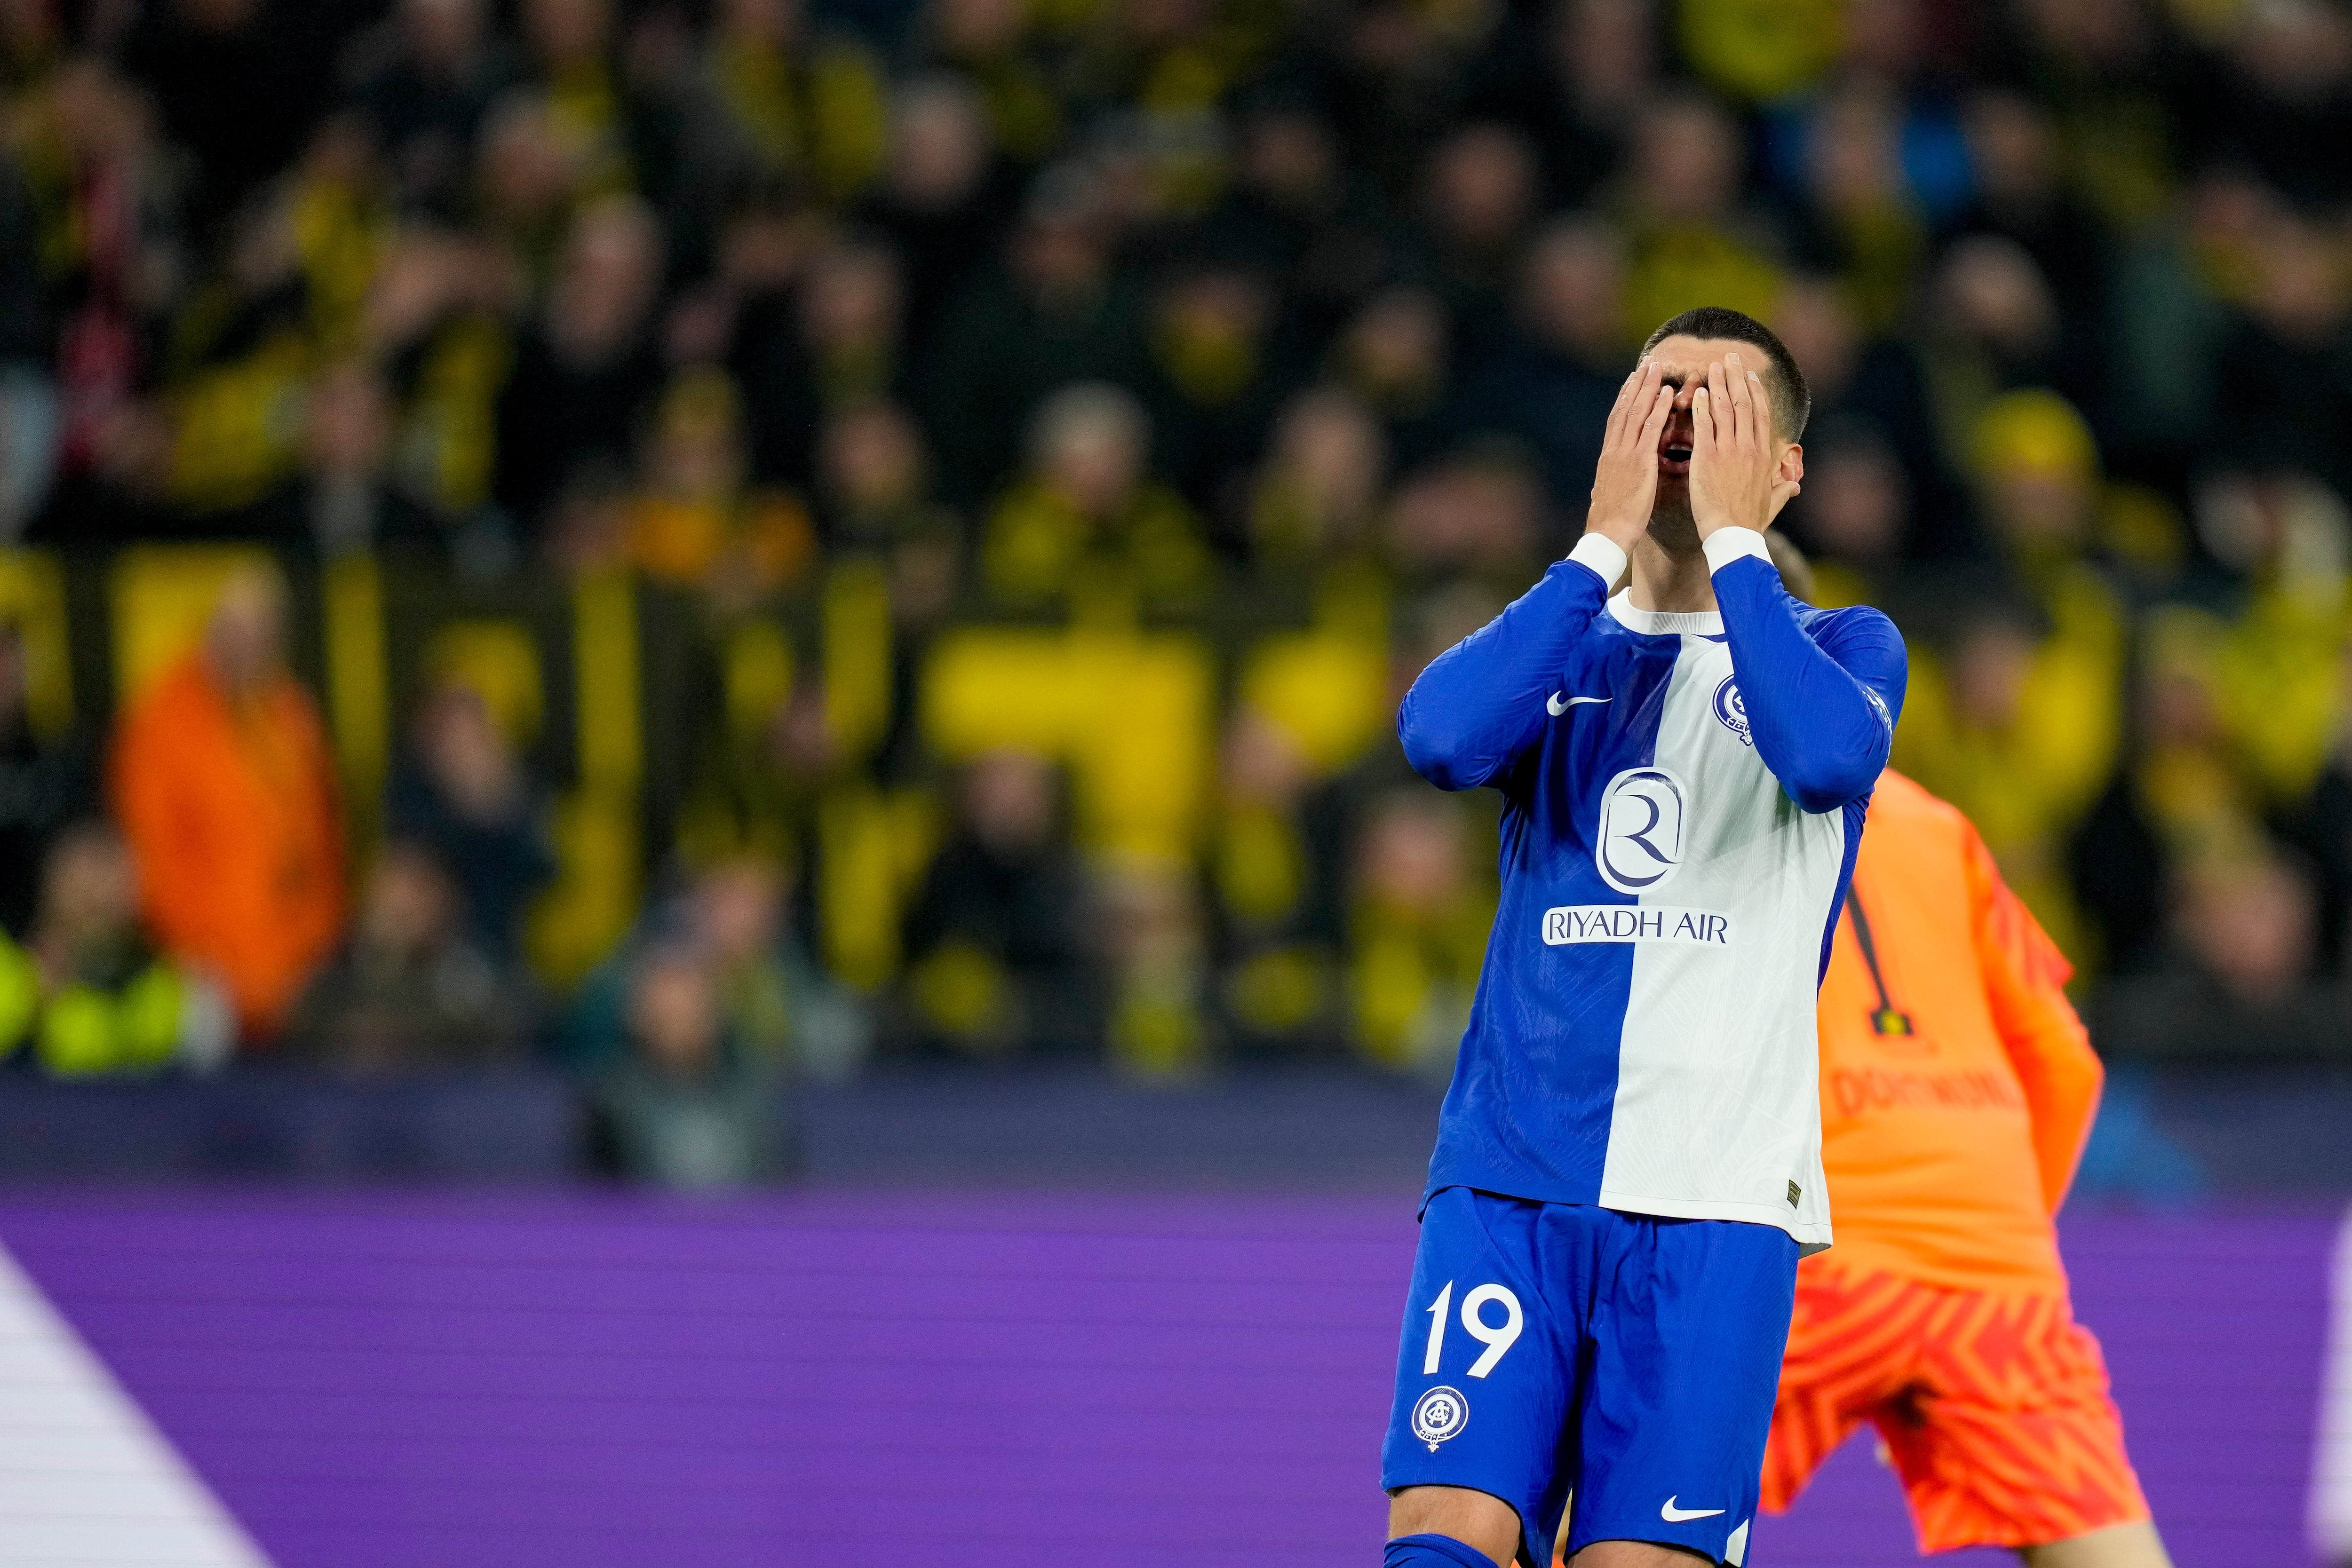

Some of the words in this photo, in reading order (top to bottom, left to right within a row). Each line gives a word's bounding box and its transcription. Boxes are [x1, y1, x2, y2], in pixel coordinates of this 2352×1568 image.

[1549, 910, 1663, 940] RIYADH
[1673, 912, 1728, 944] AIR
[1829, 1067, 2023, 1118] DORTMUN
[1423, 1279, 1524, 1379] 19
